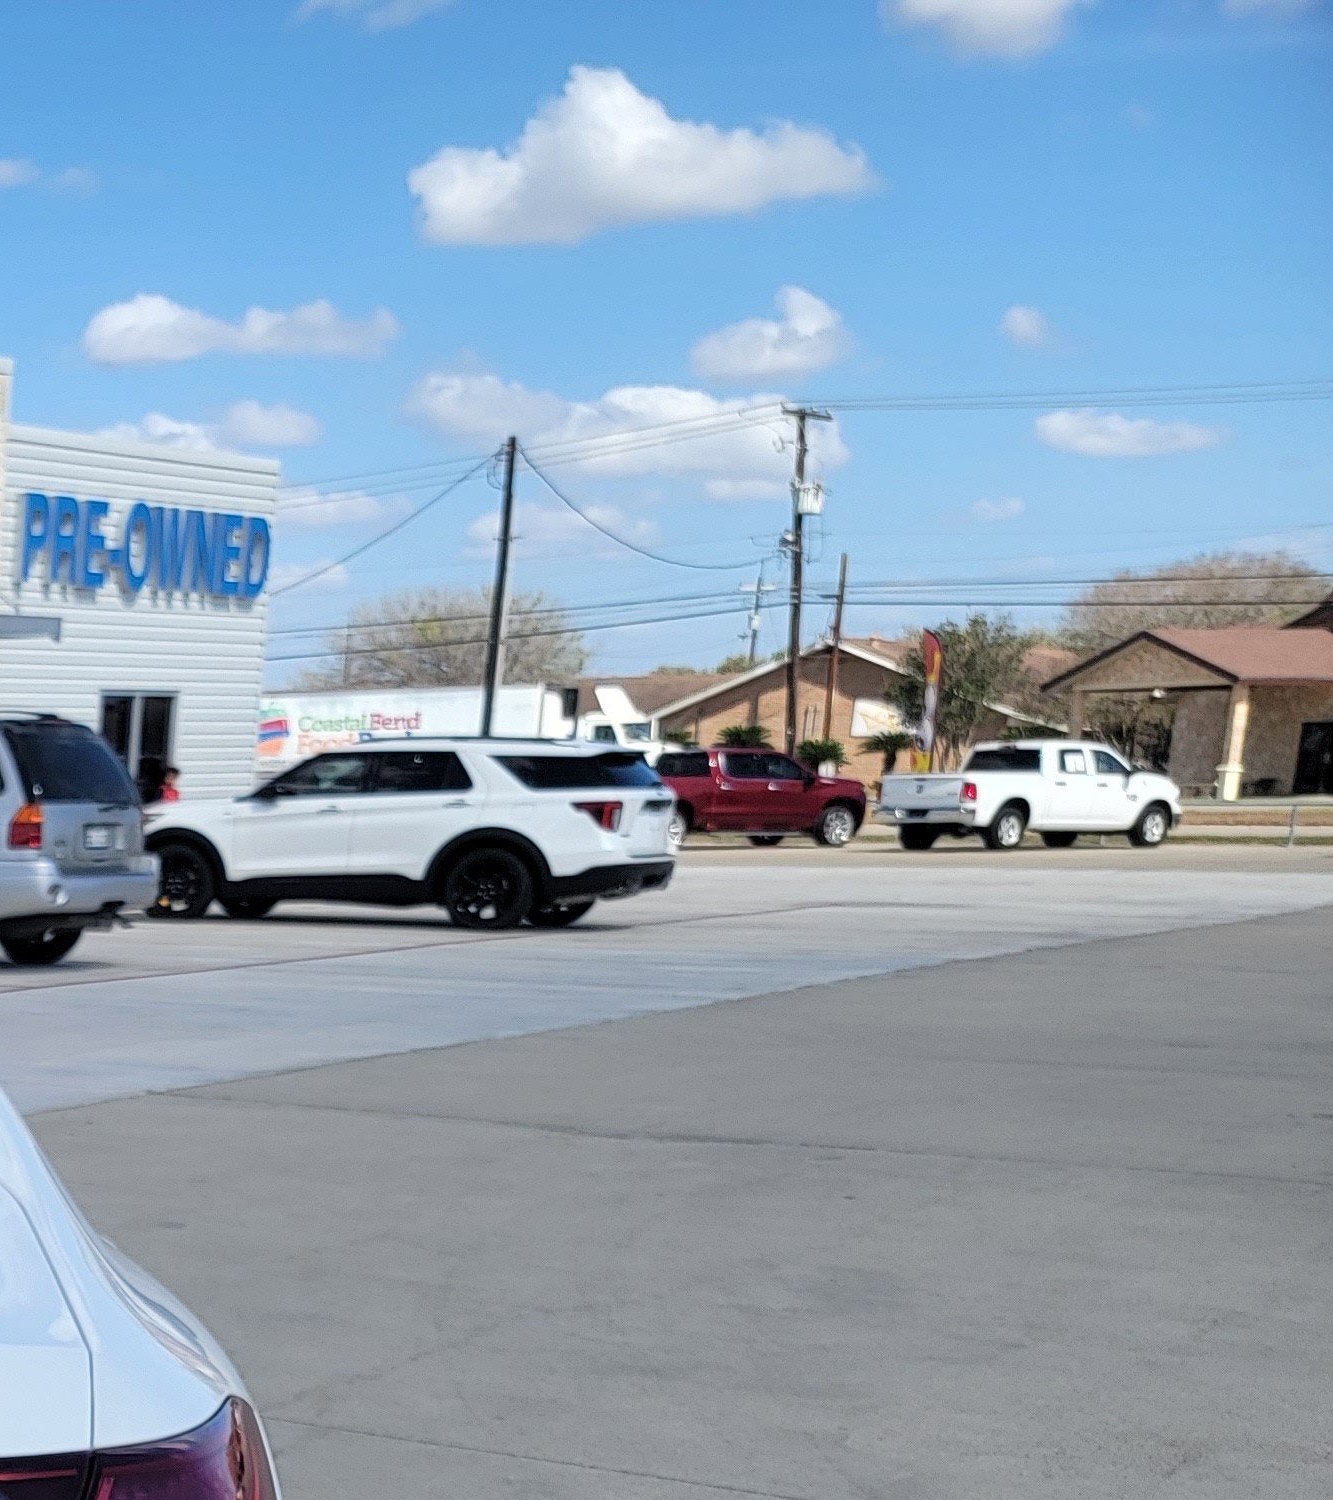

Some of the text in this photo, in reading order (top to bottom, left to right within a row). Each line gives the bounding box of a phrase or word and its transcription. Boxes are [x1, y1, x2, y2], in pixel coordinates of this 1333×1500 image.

[21, 492, 272, 600] PRE-OWNED
[297, 711, 422, 733] Coastal Bend
